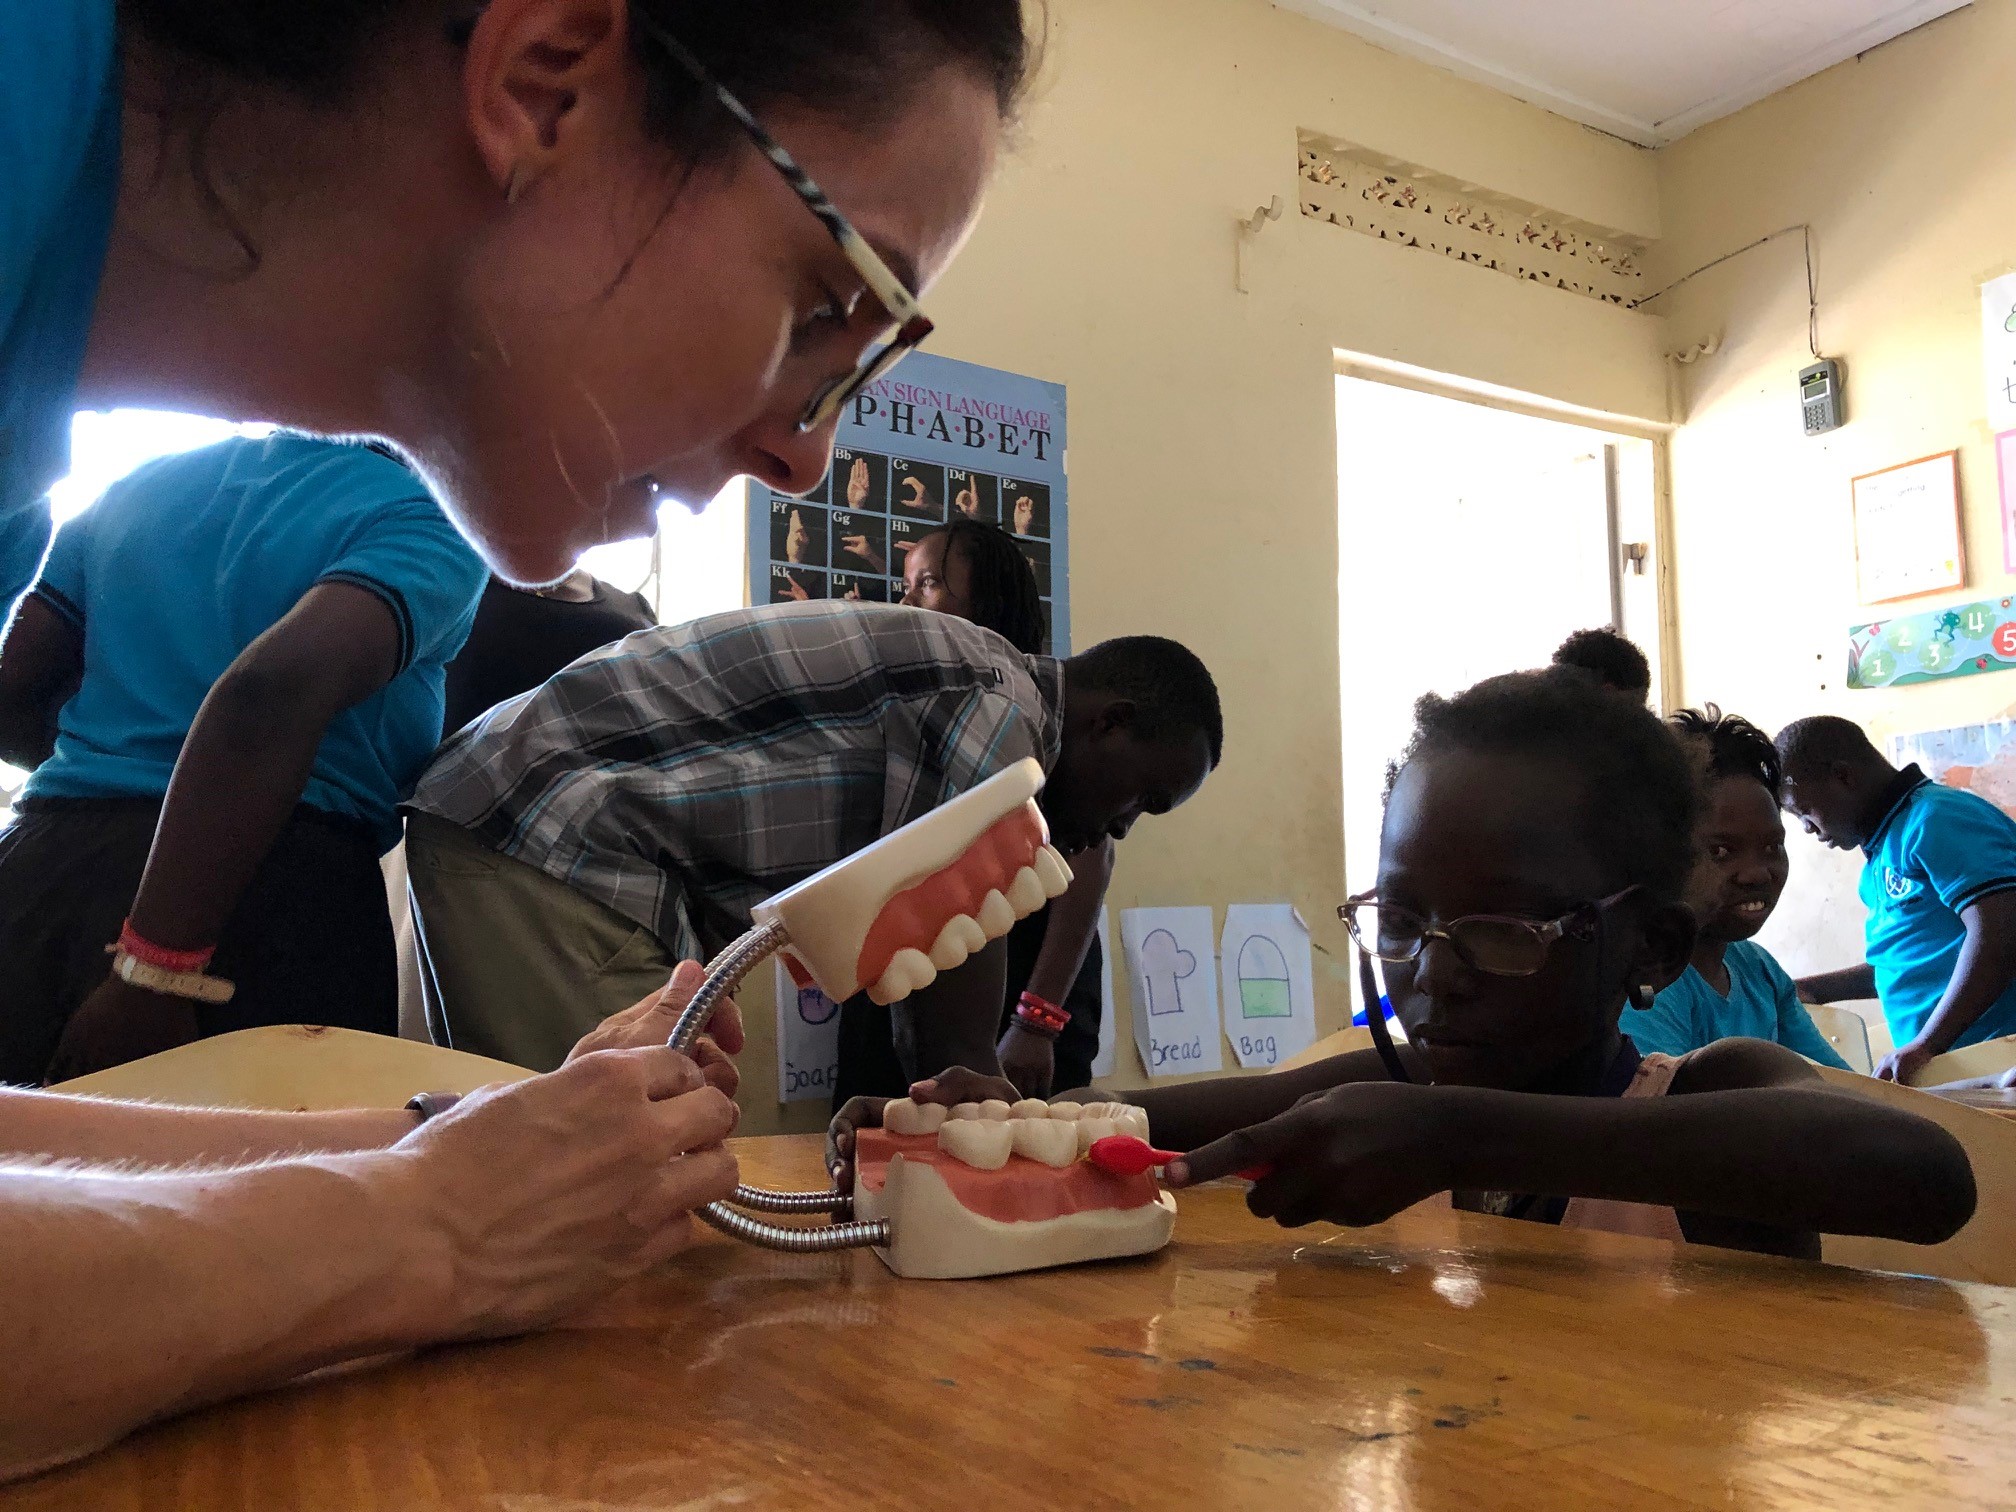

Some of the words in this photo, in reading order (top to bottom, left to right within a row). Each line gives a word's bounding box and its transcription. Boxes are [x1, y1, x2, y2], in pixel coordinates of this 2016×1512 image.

[894, 382, 942, 410] SIGN
[945, 392, 1052, 431] LANGUAGE
[834, 447, 852, 461] Bb
[893, 458, 909, 471] Cc
[949, 469, 966, 481] Dd
[1002, 478, 1017, 490] Ee
[771, 500, 788, 514] Ff
[833, 511, 850, 526] Gg
[892, 520, 910, 533] Hh
[772, 566, 790, 579] Kk
[833, 574, 846, 586] Ll
[892, 581, 903, 593] M
[1871, 658, 1886, 677] 1
[1897, 626, 1913, 647] 2
[1928, 644, 1941, 667] 3
[1968, 611, 1985, 633] 4
[2002, 628, 2016, 652] 5
[1151, 1035, 1202, 1066] Bread
[1240, 1035, 1277, 1064] Bag
